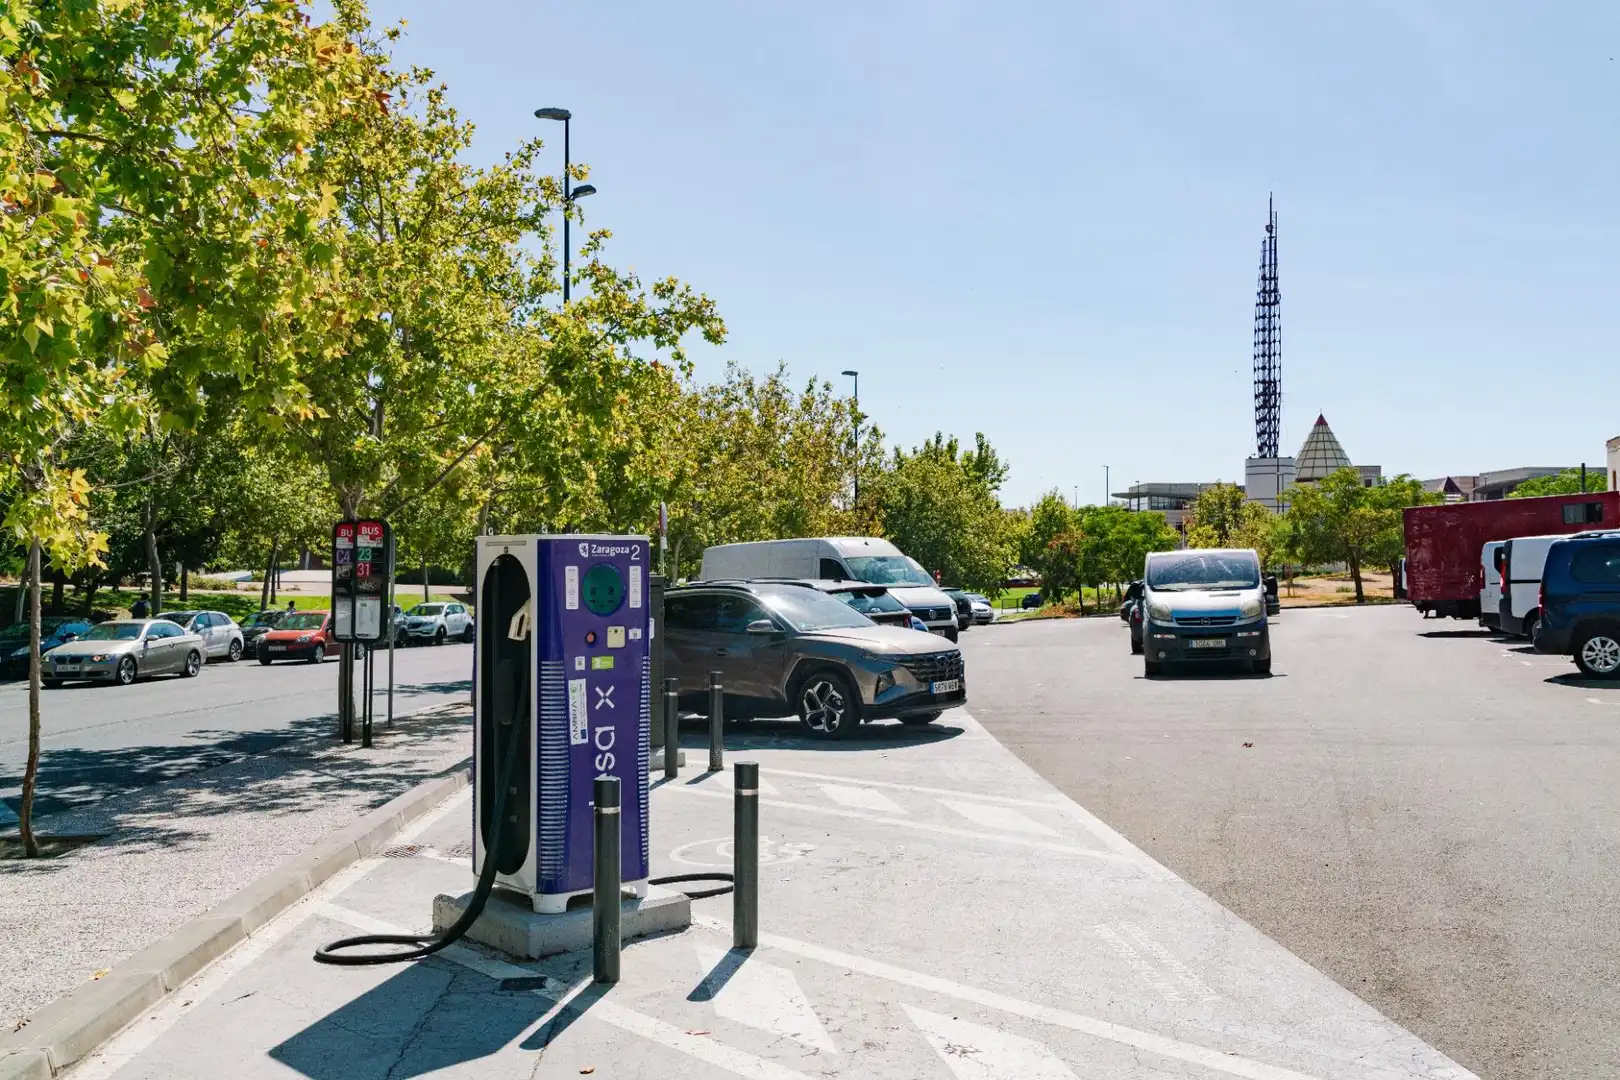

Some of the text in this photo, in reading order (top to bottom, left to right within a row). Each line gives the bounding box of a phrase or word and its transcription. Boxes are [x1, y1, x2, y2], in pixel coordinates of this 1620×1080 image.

[341, 528, 353, 537] BU
[361, 526, 379, 535] BUS
[357, 548, 372, 561] 23
[591, 544, 641, 560] Zaragoza 2
[356, 562, 370, 577] 31
